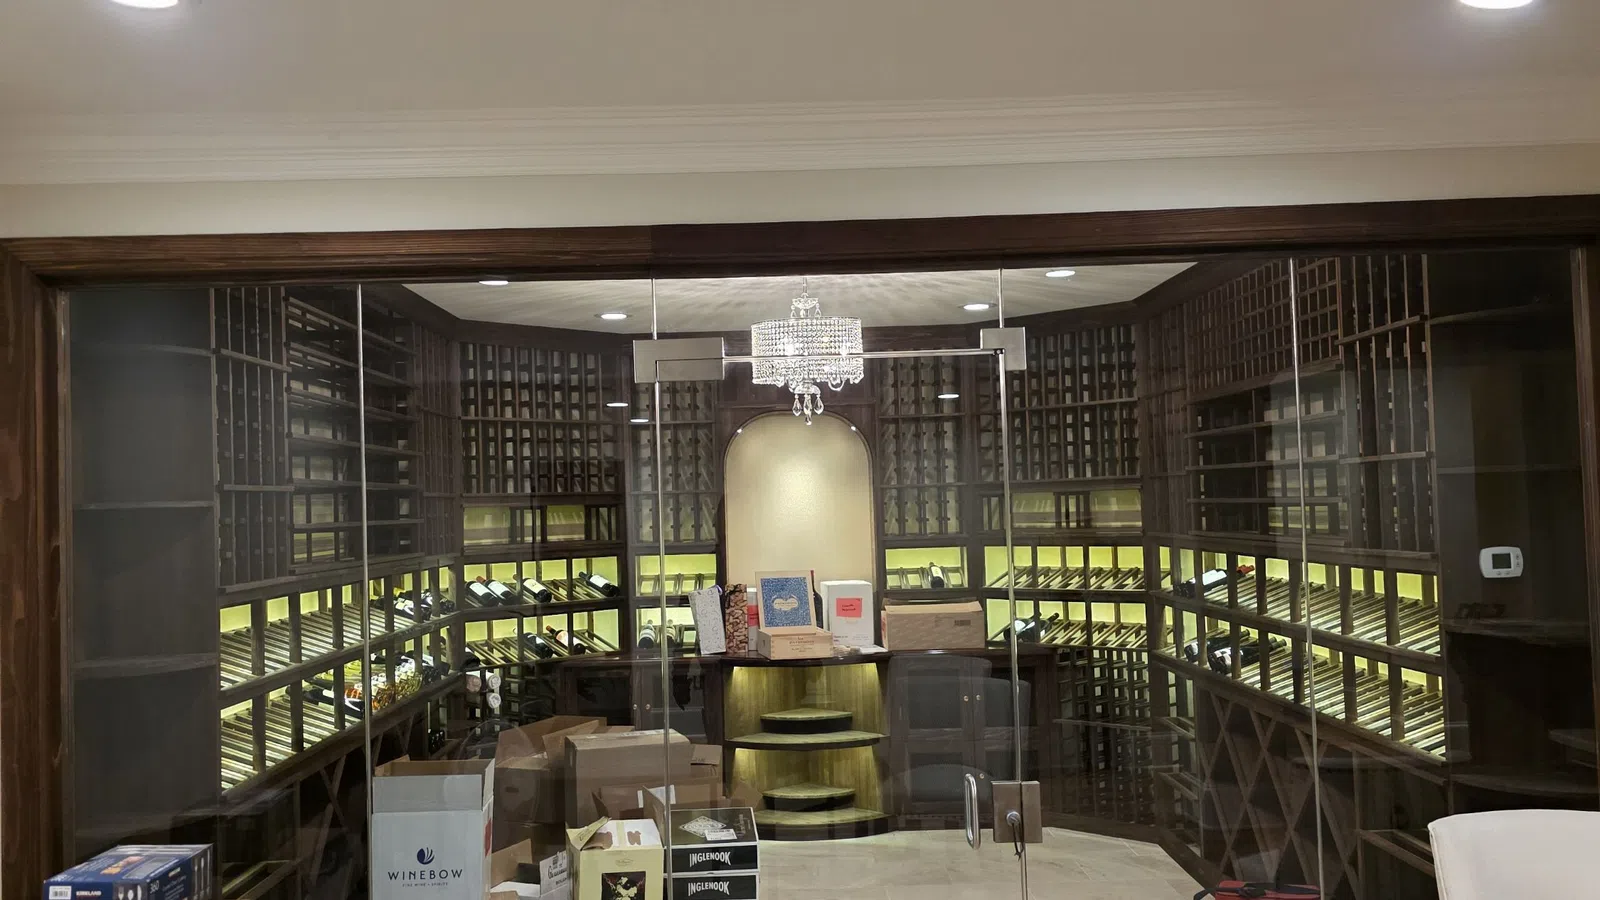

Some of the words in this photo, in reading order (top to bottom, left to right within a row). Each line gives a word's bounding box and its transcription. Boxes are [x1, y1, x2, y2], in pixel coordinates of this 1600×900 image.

[689, 851, 731, 867] INGLENOOK
[387, 868, 463, 881] WINEBOW
[687, 881, 730, 897] INGLENOOK
